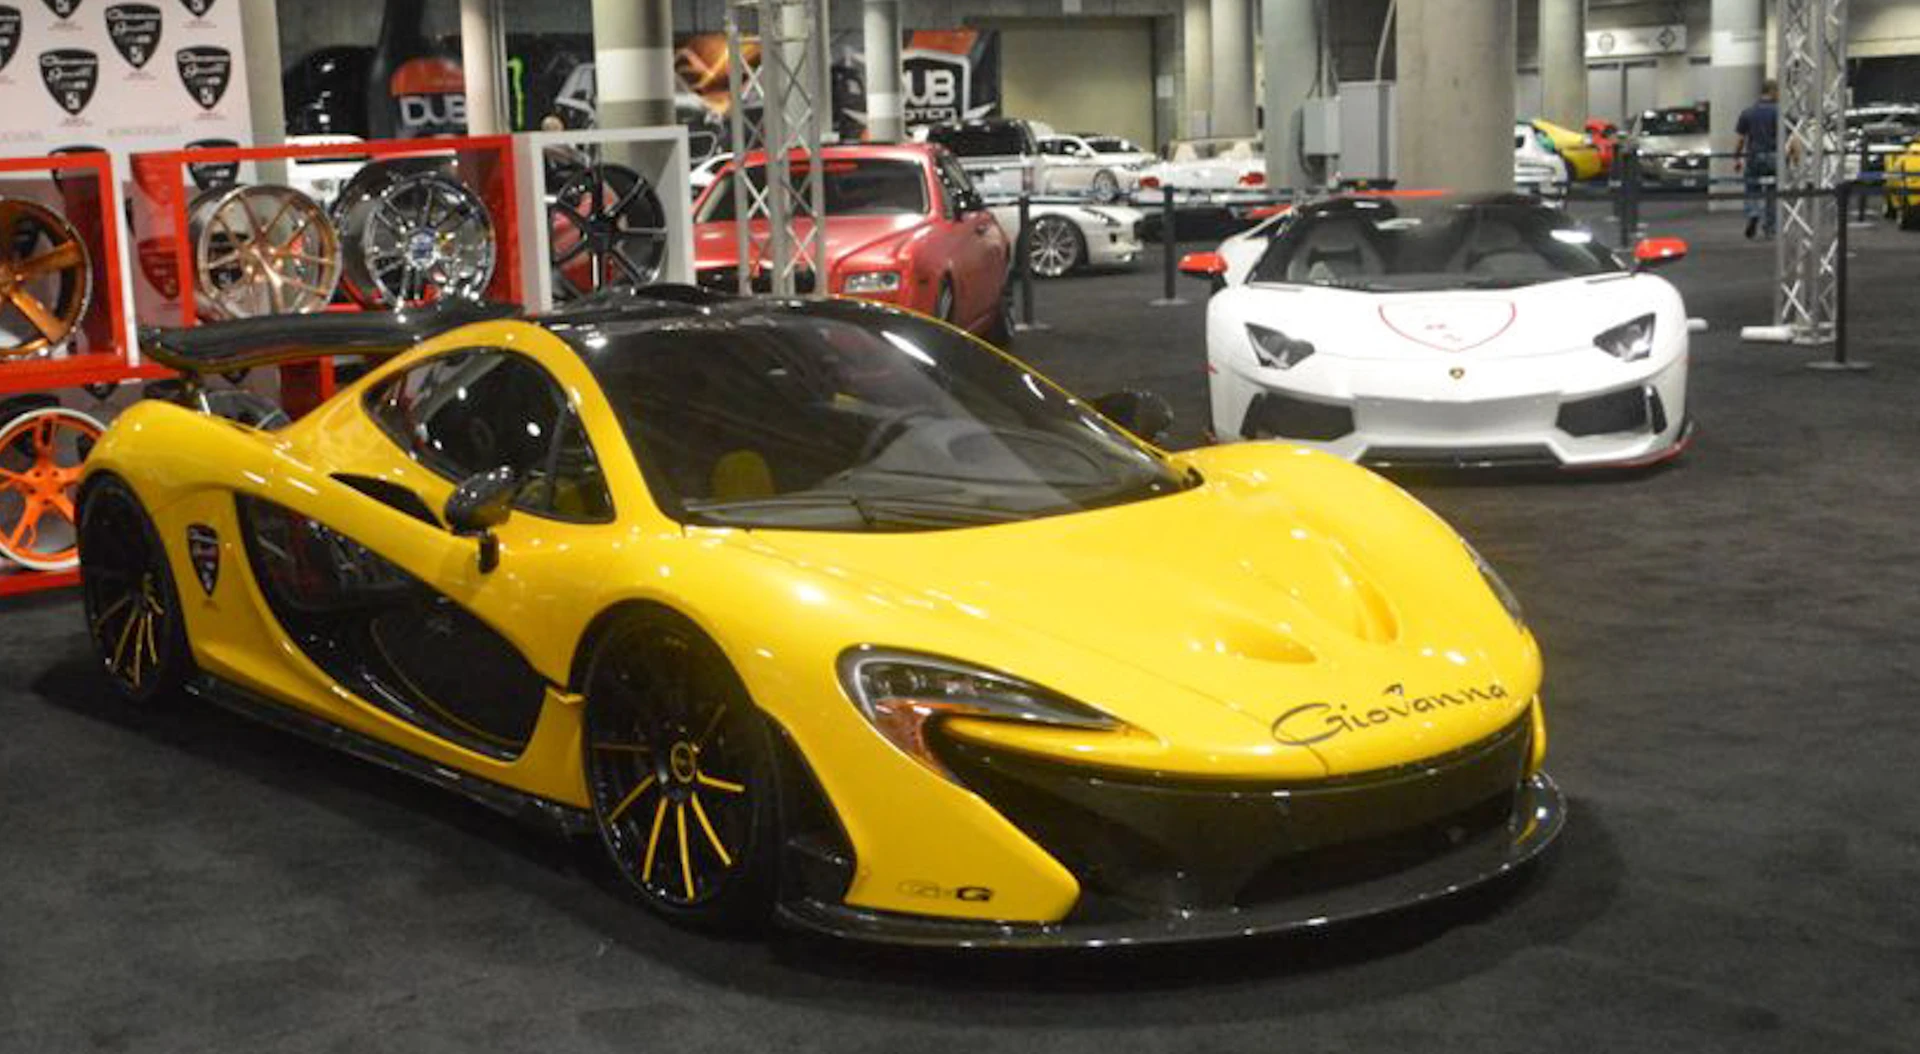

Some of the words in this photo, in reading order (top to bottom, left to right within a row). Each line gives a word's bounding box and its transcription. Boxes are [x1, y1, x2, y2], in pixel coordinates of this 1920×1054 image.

[901, 69, 956, 106] UB
[399, 95, 467, 126] DUB
[1271, 683, 1508, 746] Giovanna
